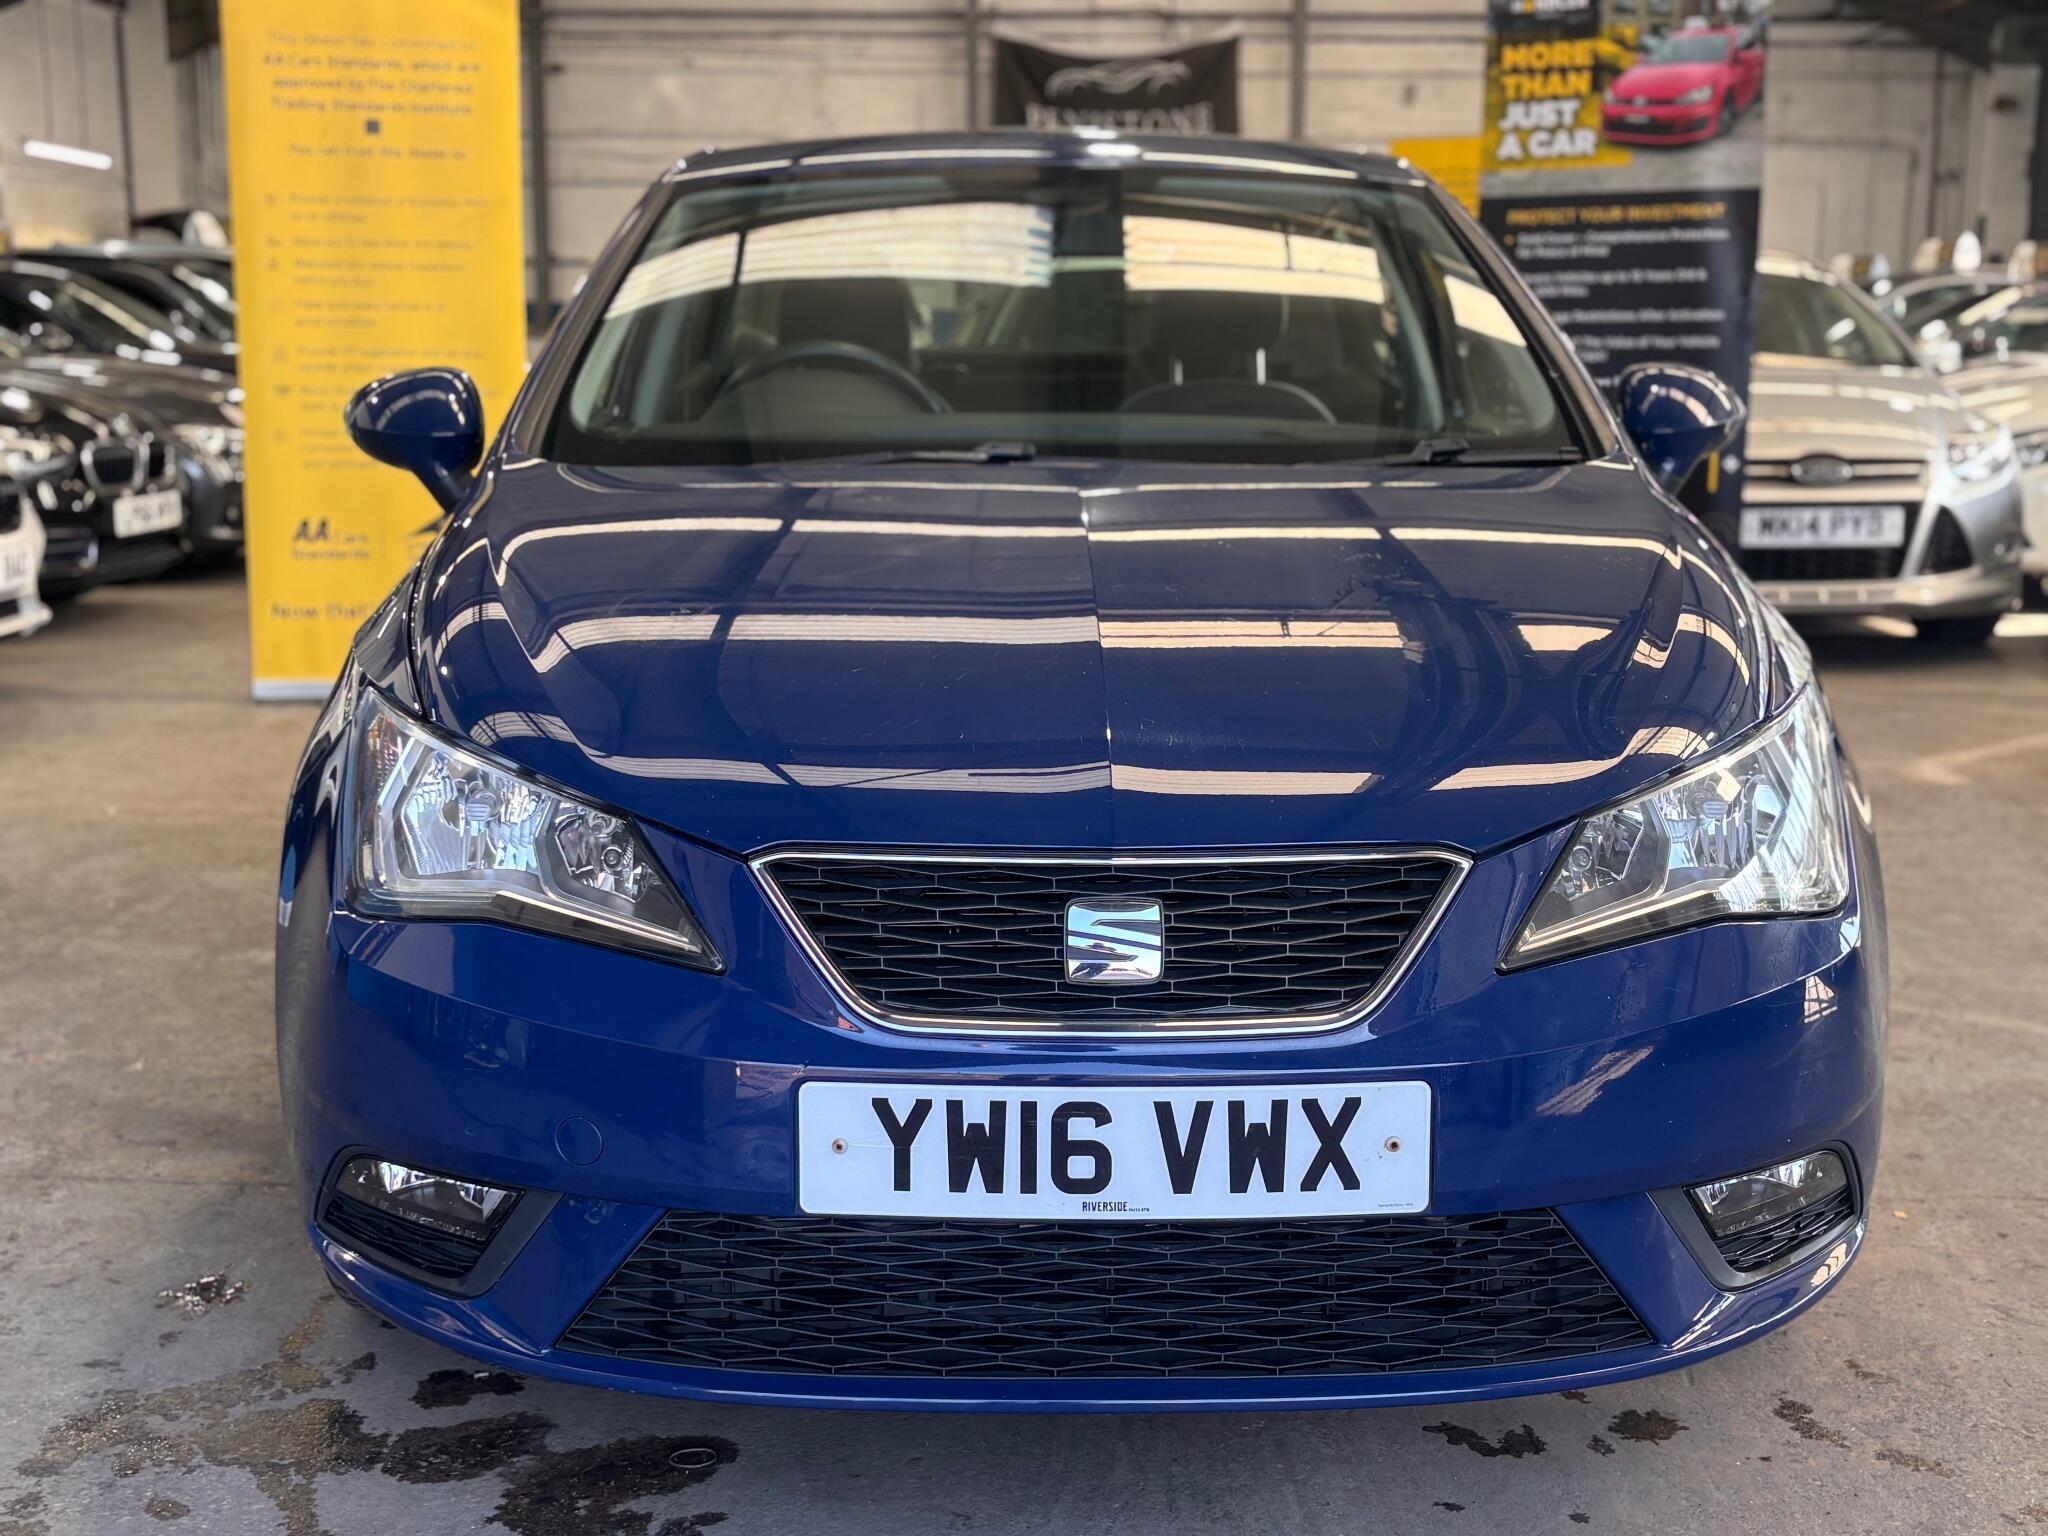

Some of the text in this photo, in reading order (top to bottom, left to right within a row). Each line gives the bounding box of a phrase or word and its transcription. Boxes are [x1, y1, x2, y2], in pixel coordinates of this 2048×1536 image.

[1502, 40, 1594, 69] MORE
[1502, 70, 1592, 98] THAN
[1499, 99, 1580, 129] JUST
[1497, 128, 1598, 160] A CAR
[1506, 202, 1727, 226] PROTECT YOUR INVESTMENT
[293, 516, 330, 543] AA
[871, 1096, 1362, 1195] YW16 VWX
[1082, 1201, 1128, 1212] RIVERSIDE
